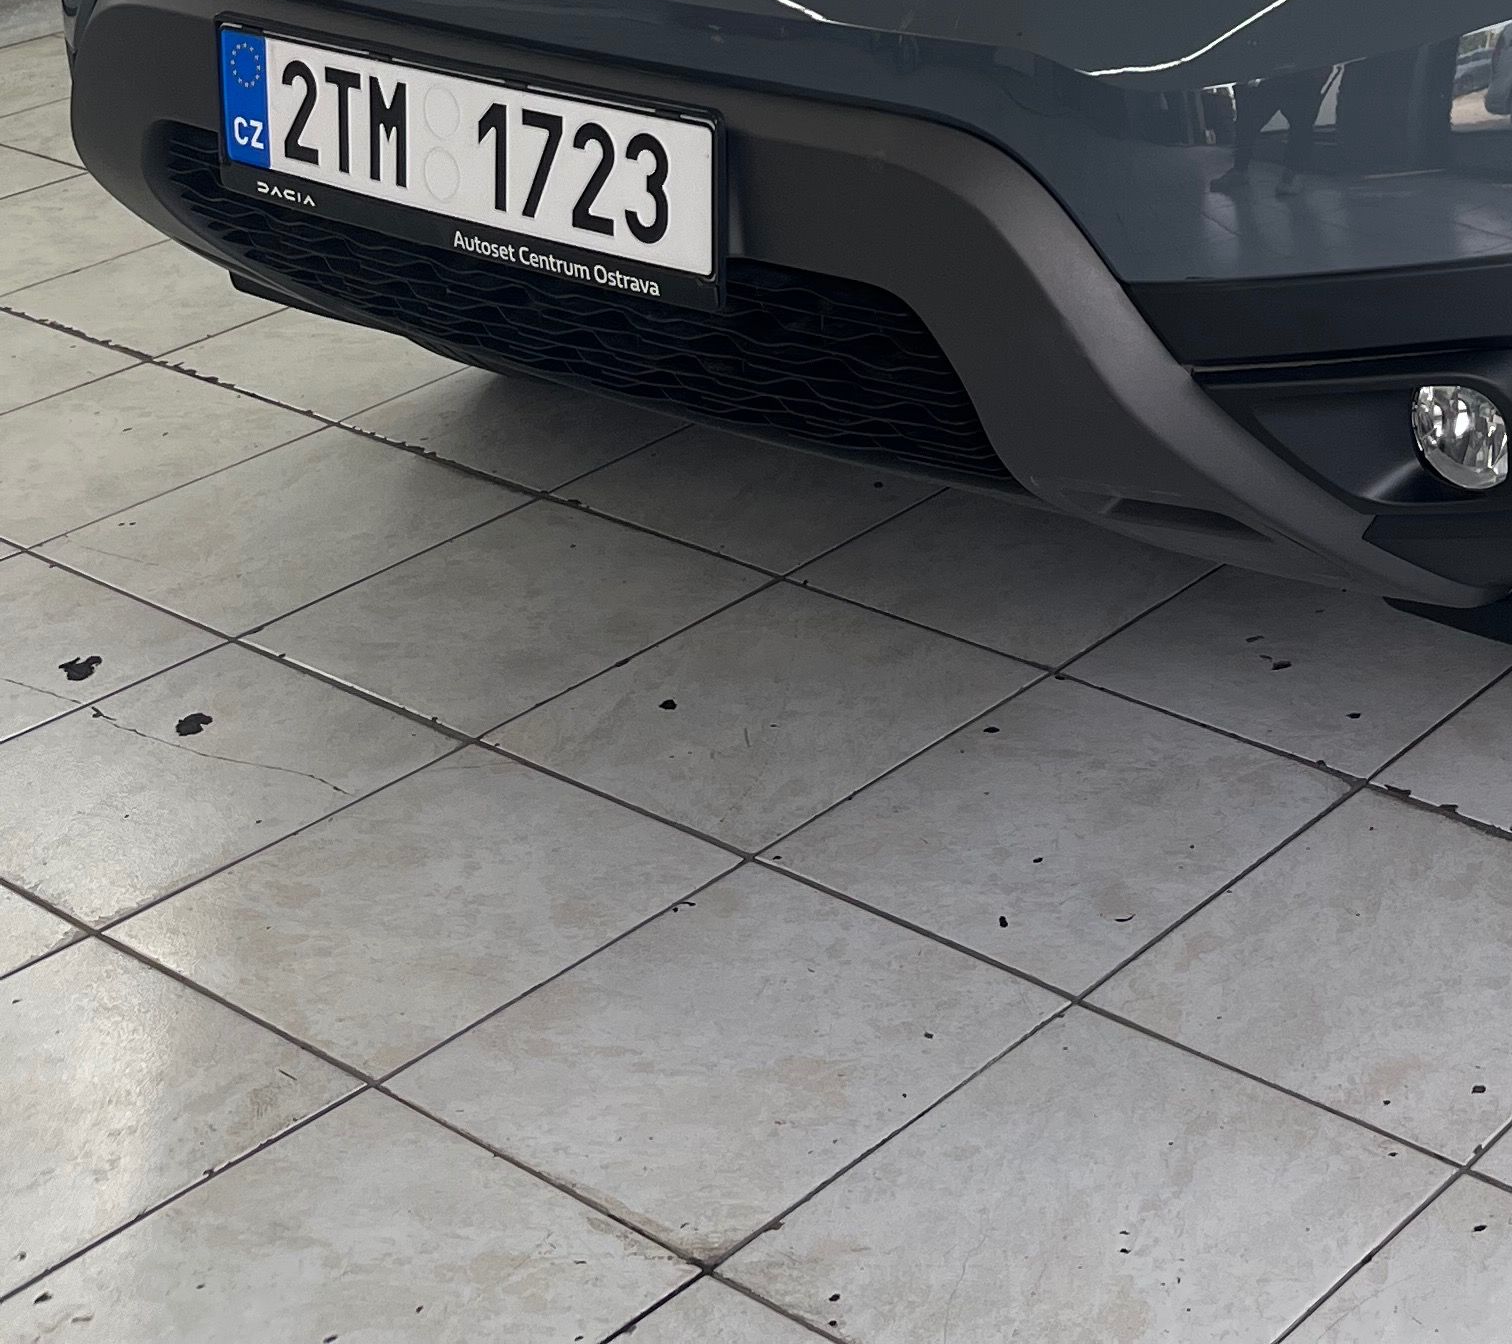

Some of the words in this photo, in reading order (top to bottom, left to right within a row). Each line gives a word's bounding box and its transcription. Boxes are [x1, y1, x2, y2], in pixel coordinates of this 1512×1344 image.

[234, 116, 264, 150] CZ
[282, 60, 407, 188] 2TM
[478, 103, 669, 244] 1723
[257, 181, 316, 207] DACIA
[453, 230, 515, 263] Autoset
[519, 246, 591, 281] Centrum
[593, 264, 661, 297] Ostrava
